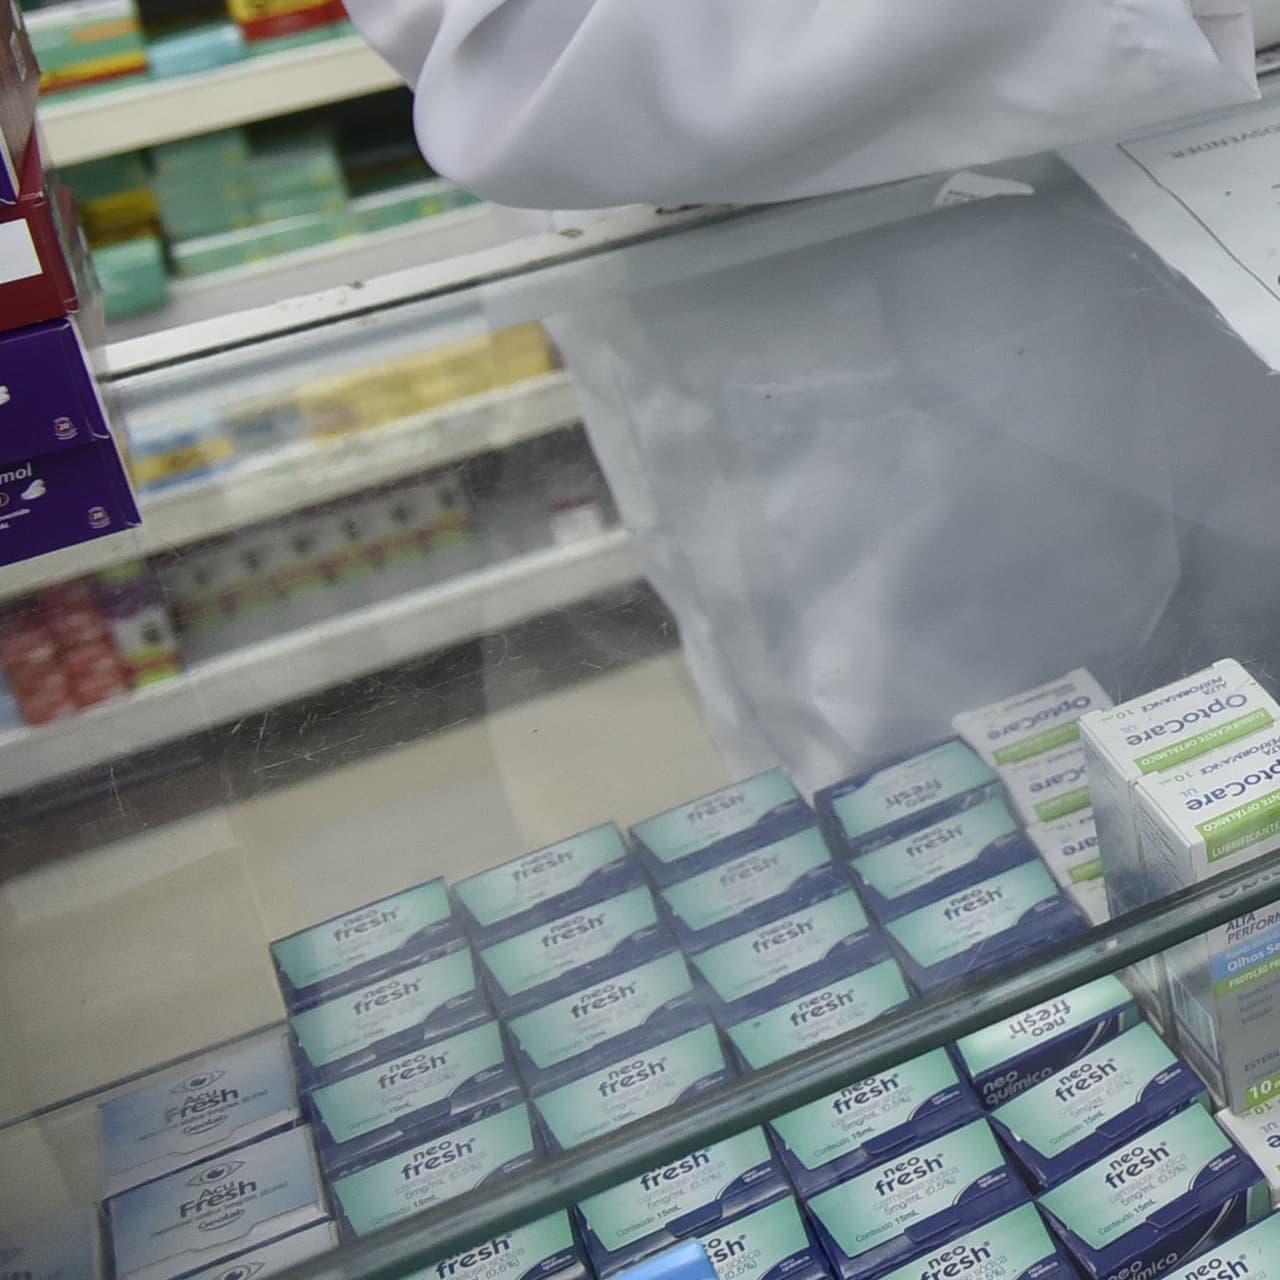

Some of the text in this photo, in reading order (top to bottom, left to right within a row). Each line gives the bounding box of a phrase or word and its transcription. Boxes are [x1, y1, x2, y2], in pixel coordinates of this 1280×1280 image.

[1126, 693, 1247, 747] OptoCare
[1202, 802, 1260, 832] OFTÁLMICO
[942, 888, 1003, 921] fresh
[1227, 951, 1265, 973] Olhos
[790, 992, 854, 1026] fresh
[377, 1054, 447, 1089] fresh
[598, 1061, 666, 1097] fresh
[982, 1070, 1018, 1095] neo
[1054, 1060, 1118, 1103] fresh
[1058, 1063, 1093, 1087] neo
[832, 1075, 900, 1115] fresh
[1249, 1079, 1272, 1099] 10
[401, 1142, 473, 1180] fresh
[883, 1156, 921, 1179] neo
[1104, 1143, 1171, 1189] fresh
[1109, 1145, 1145, 1170] neo
[874, 1156, 943, 1196] fresh
[895, 1210, 920, 1225] 15mL
[1134, 1198, 1157, 1215] 15mL
[927, 1244, 967, 1269] neo
